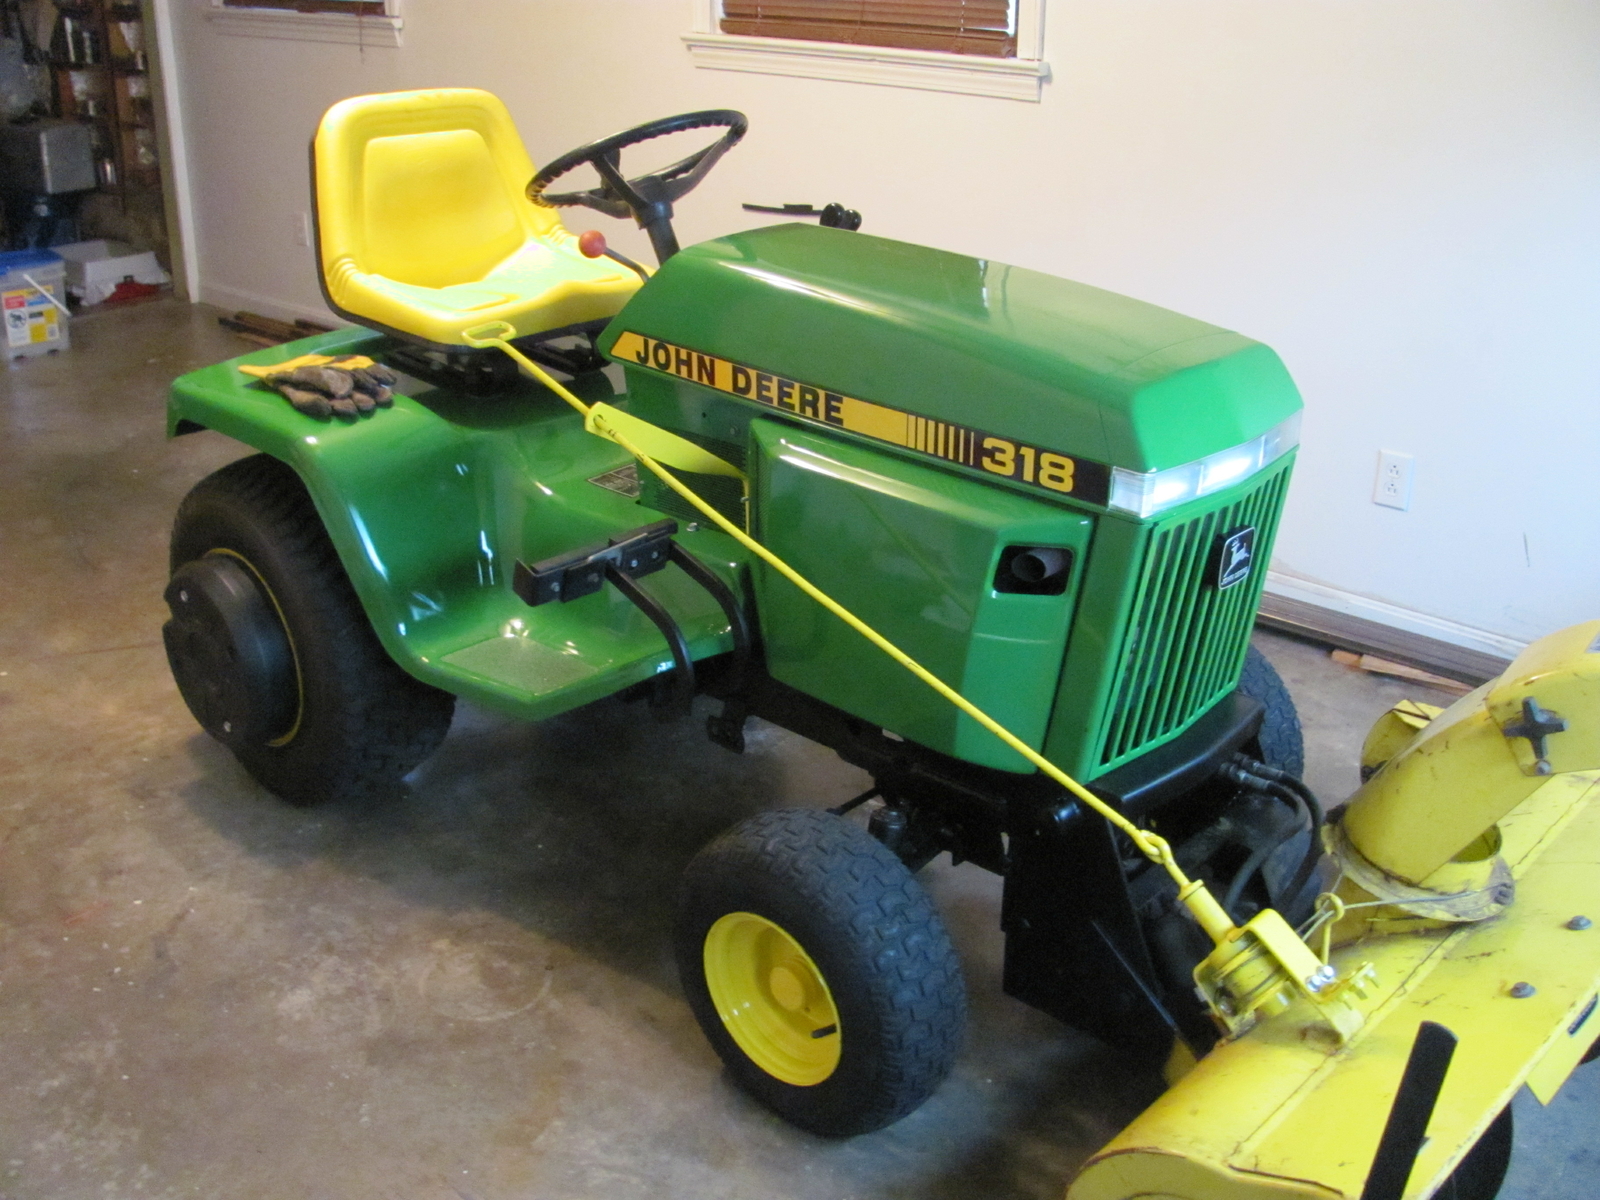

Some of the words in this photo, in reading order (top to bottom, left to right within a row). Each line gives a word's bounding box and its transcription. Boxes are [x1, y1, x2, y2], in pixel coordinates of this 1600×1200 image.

[635, 338, 716, 386] JOHN
[731, 365, 844, 426] DEERE
[982, 437, 1075, 493] 318
